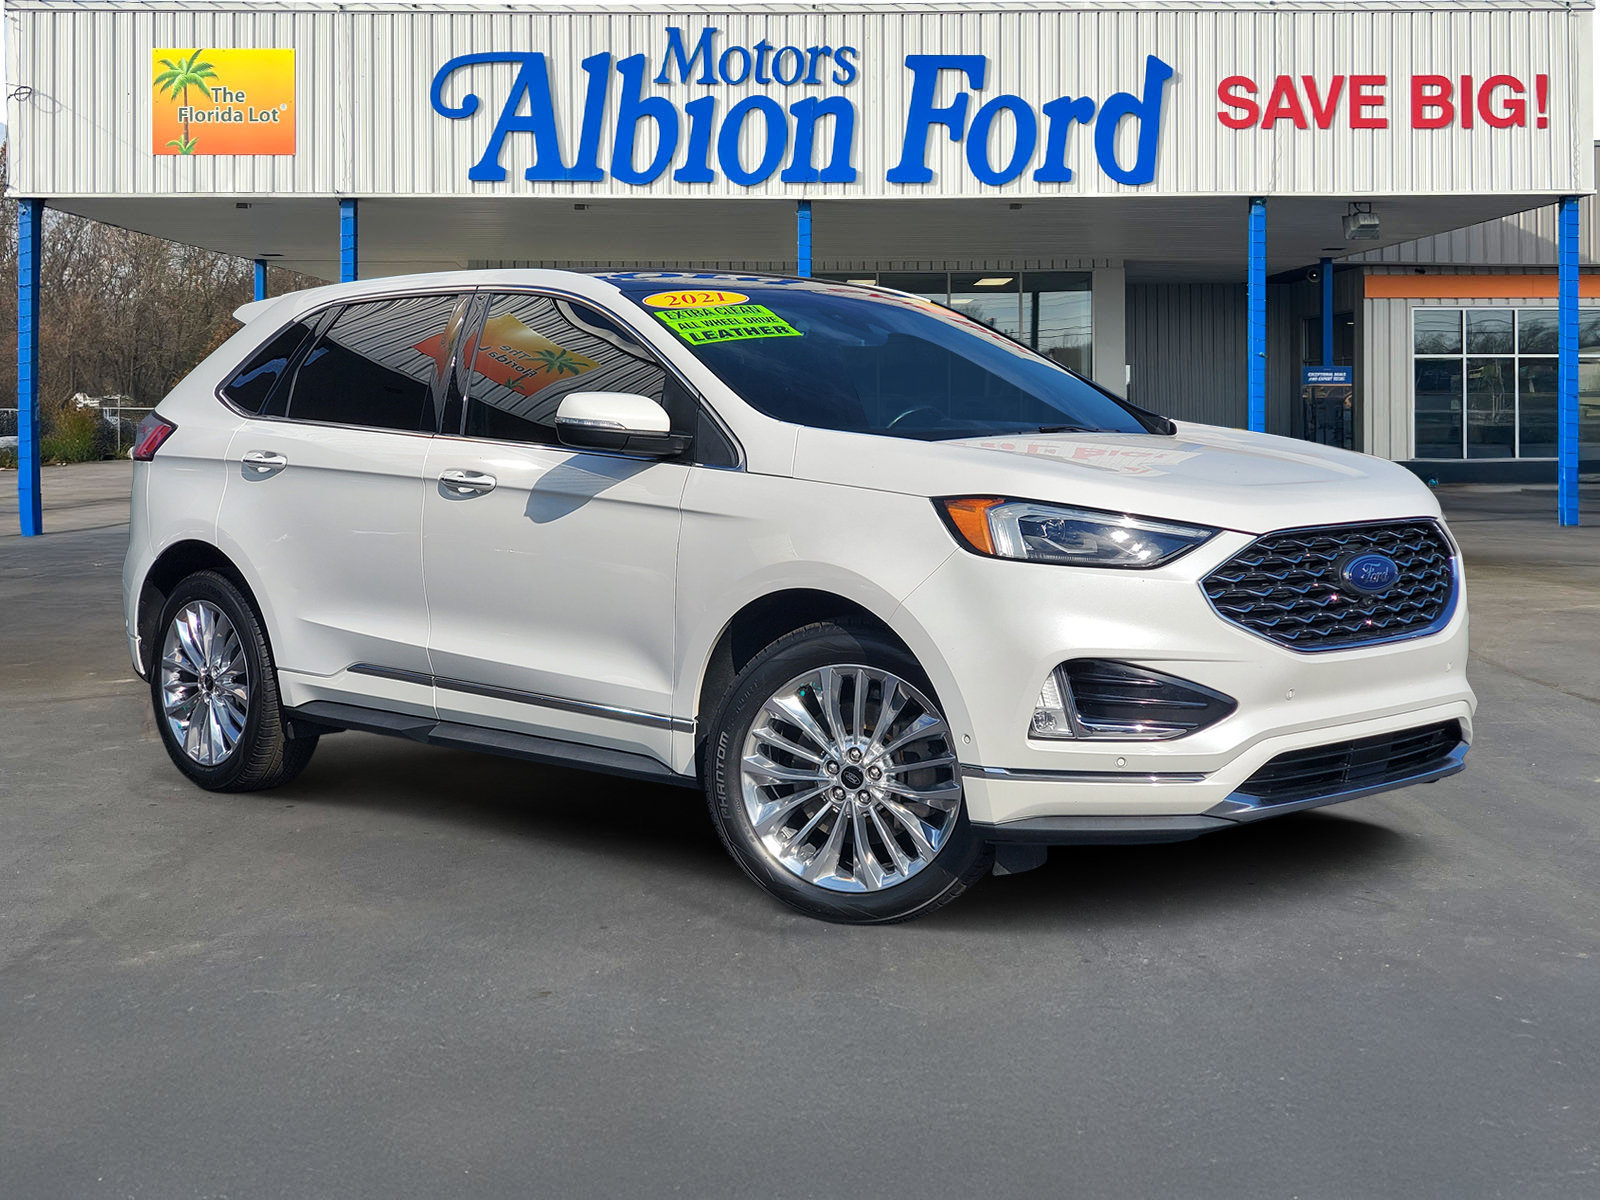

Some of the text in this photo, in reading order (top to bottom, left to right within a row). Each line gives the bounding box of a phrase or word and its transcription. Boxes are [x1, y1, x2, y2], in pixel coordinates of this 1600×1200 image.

[653, 26, 858, 86] Motors
[211, 87, 246, 103] The
[1217, 74, 1549, 130] SAVE BIG!
[178, 107, 280, 123] Florida Lot
[430, 51, 1173, 186] Albion Ford
[664, 292, 726, 307] 2021
[663, 305, 763, 320] EXTRA CLEAN
[677, 316, 780, 331] ALL WHEEL DRIVE
[689, 325, 792, 342] LEATHER
[1360, 562, 1390, 583] Ford
